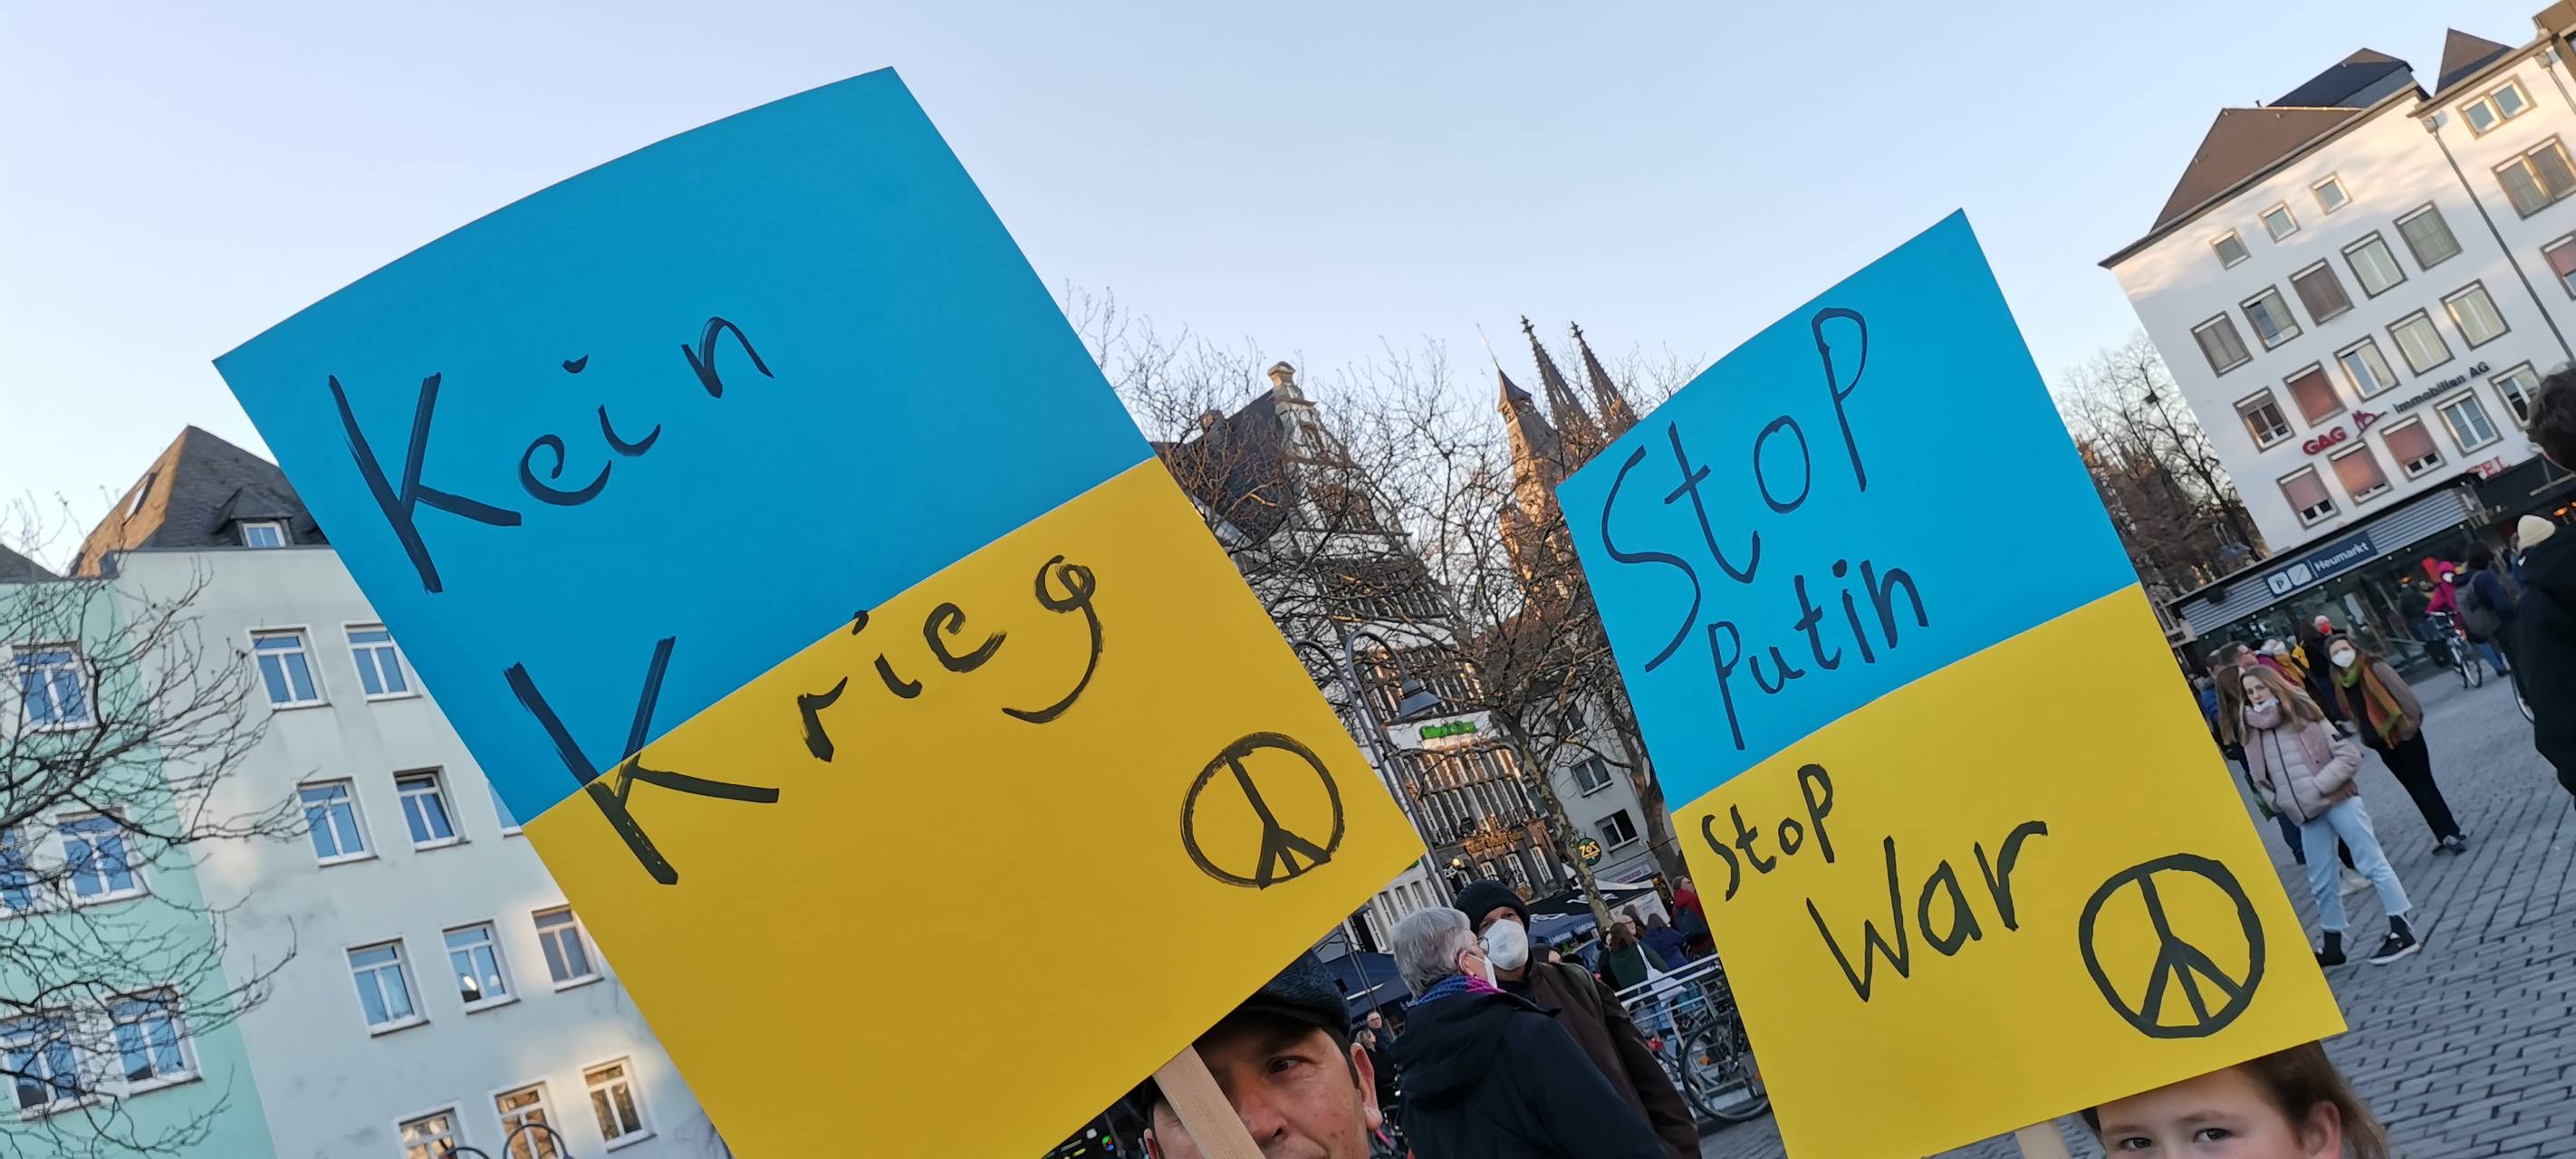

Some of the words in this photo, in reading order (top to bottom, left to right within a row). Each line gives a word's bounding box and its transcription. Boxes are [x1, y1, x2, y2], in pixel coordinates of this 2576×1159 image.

[329, 317, 774, 595] Kein
[2302, 426, 2348, 455] GAG
[2469, 361, 2490, 378] AG
[2313, 541, 2369, 571] Heumarkt
[504, 554, 1102, 886] Krieg
[1707, 559, 1929, 751] Putin
[1806, 819, 2048, 1003] War
